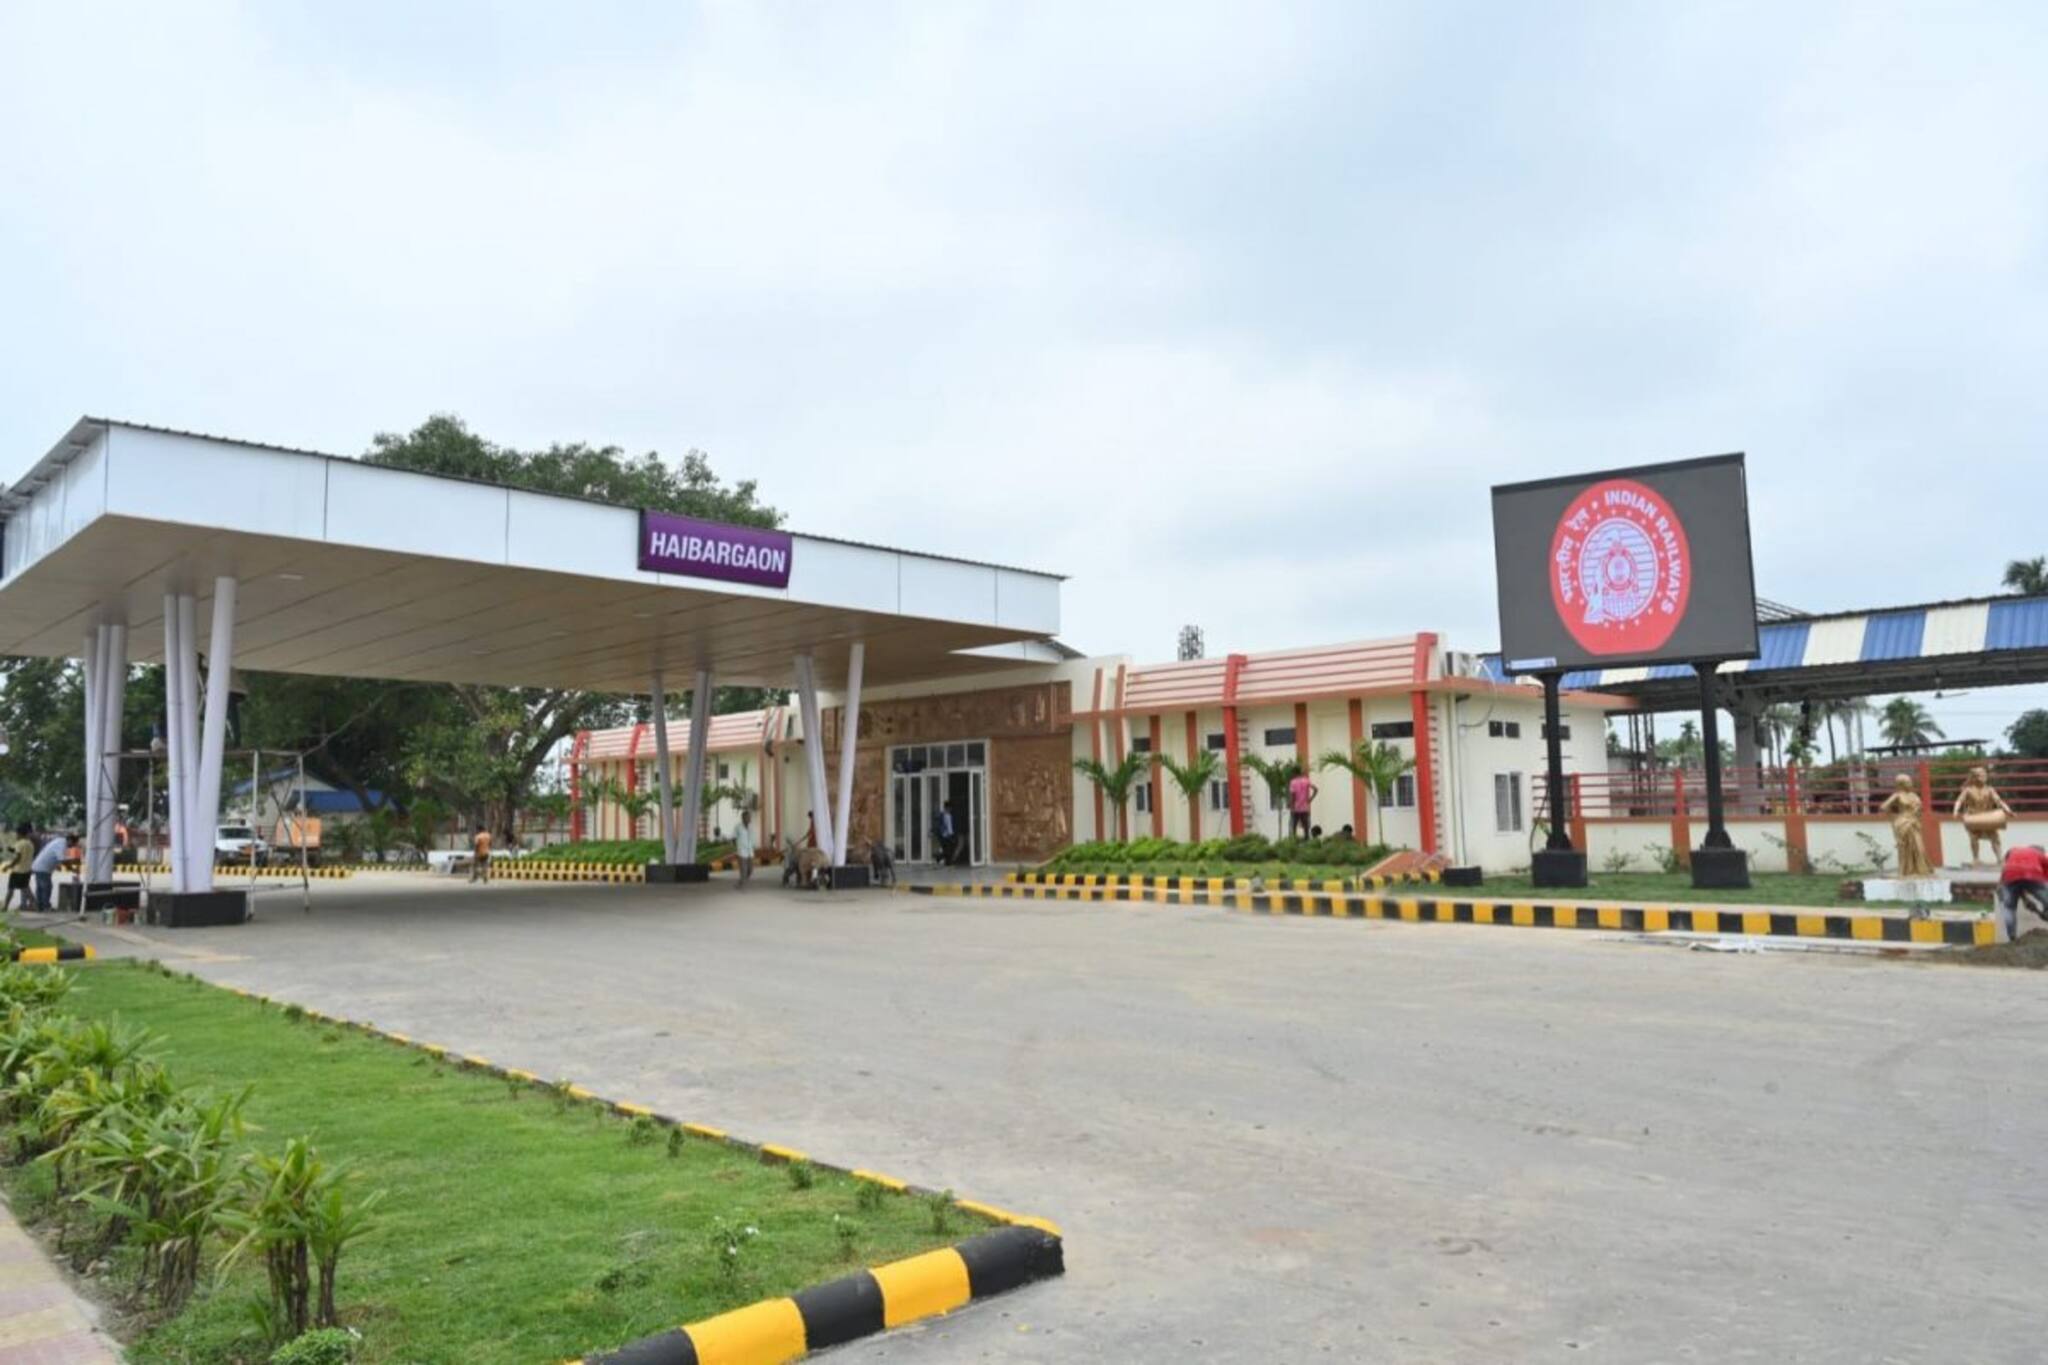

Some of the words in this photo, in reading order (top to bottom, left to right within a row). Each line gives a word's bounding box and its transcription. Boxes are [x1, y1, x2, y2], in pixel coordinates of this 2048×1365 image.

[650, 531, 786, 573] HAIBARGAON
[1605, 490, 1658, 518] INDIAN
[1655, 516, 1681, 614] RAILWAYS
